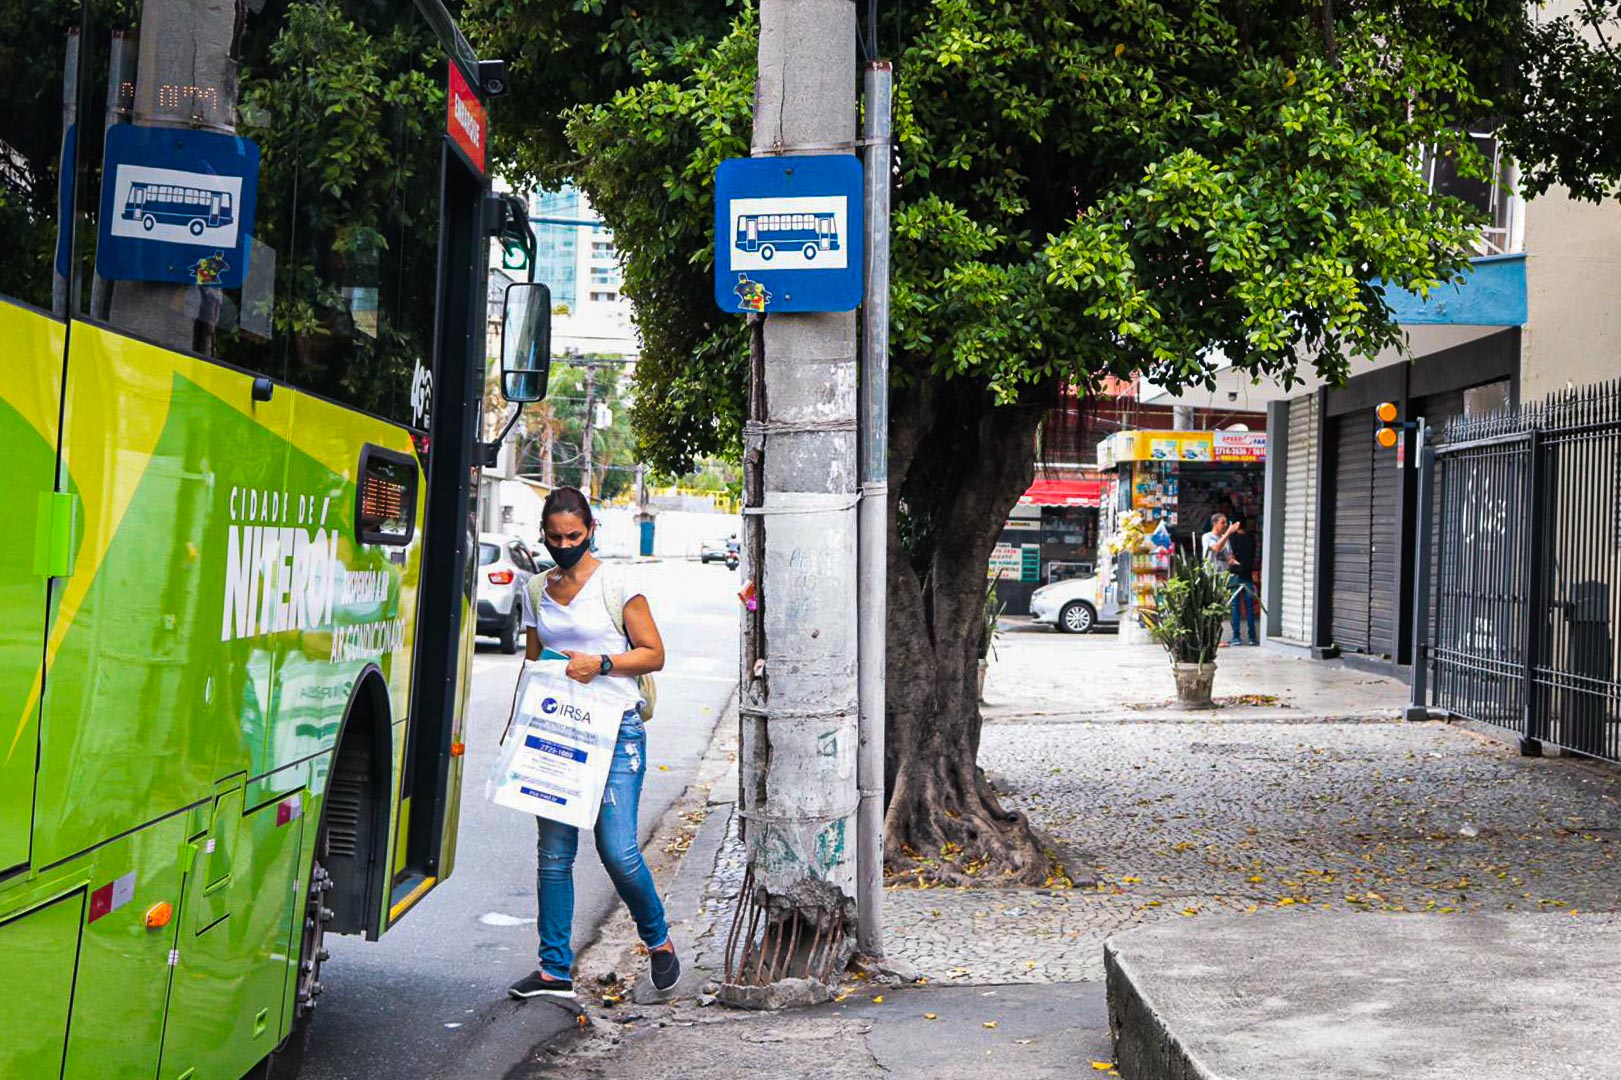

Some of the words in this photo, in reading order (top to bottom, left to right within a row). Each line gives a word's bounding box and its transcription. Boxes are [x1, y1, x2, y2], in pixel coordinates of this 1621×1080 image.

[229, 485, 289, 523] CIDADE
[298, 494, 315, 525] DE
[221, 496, 339, 643] NITERÓI
[559, 703, 592, 725] IRSA
